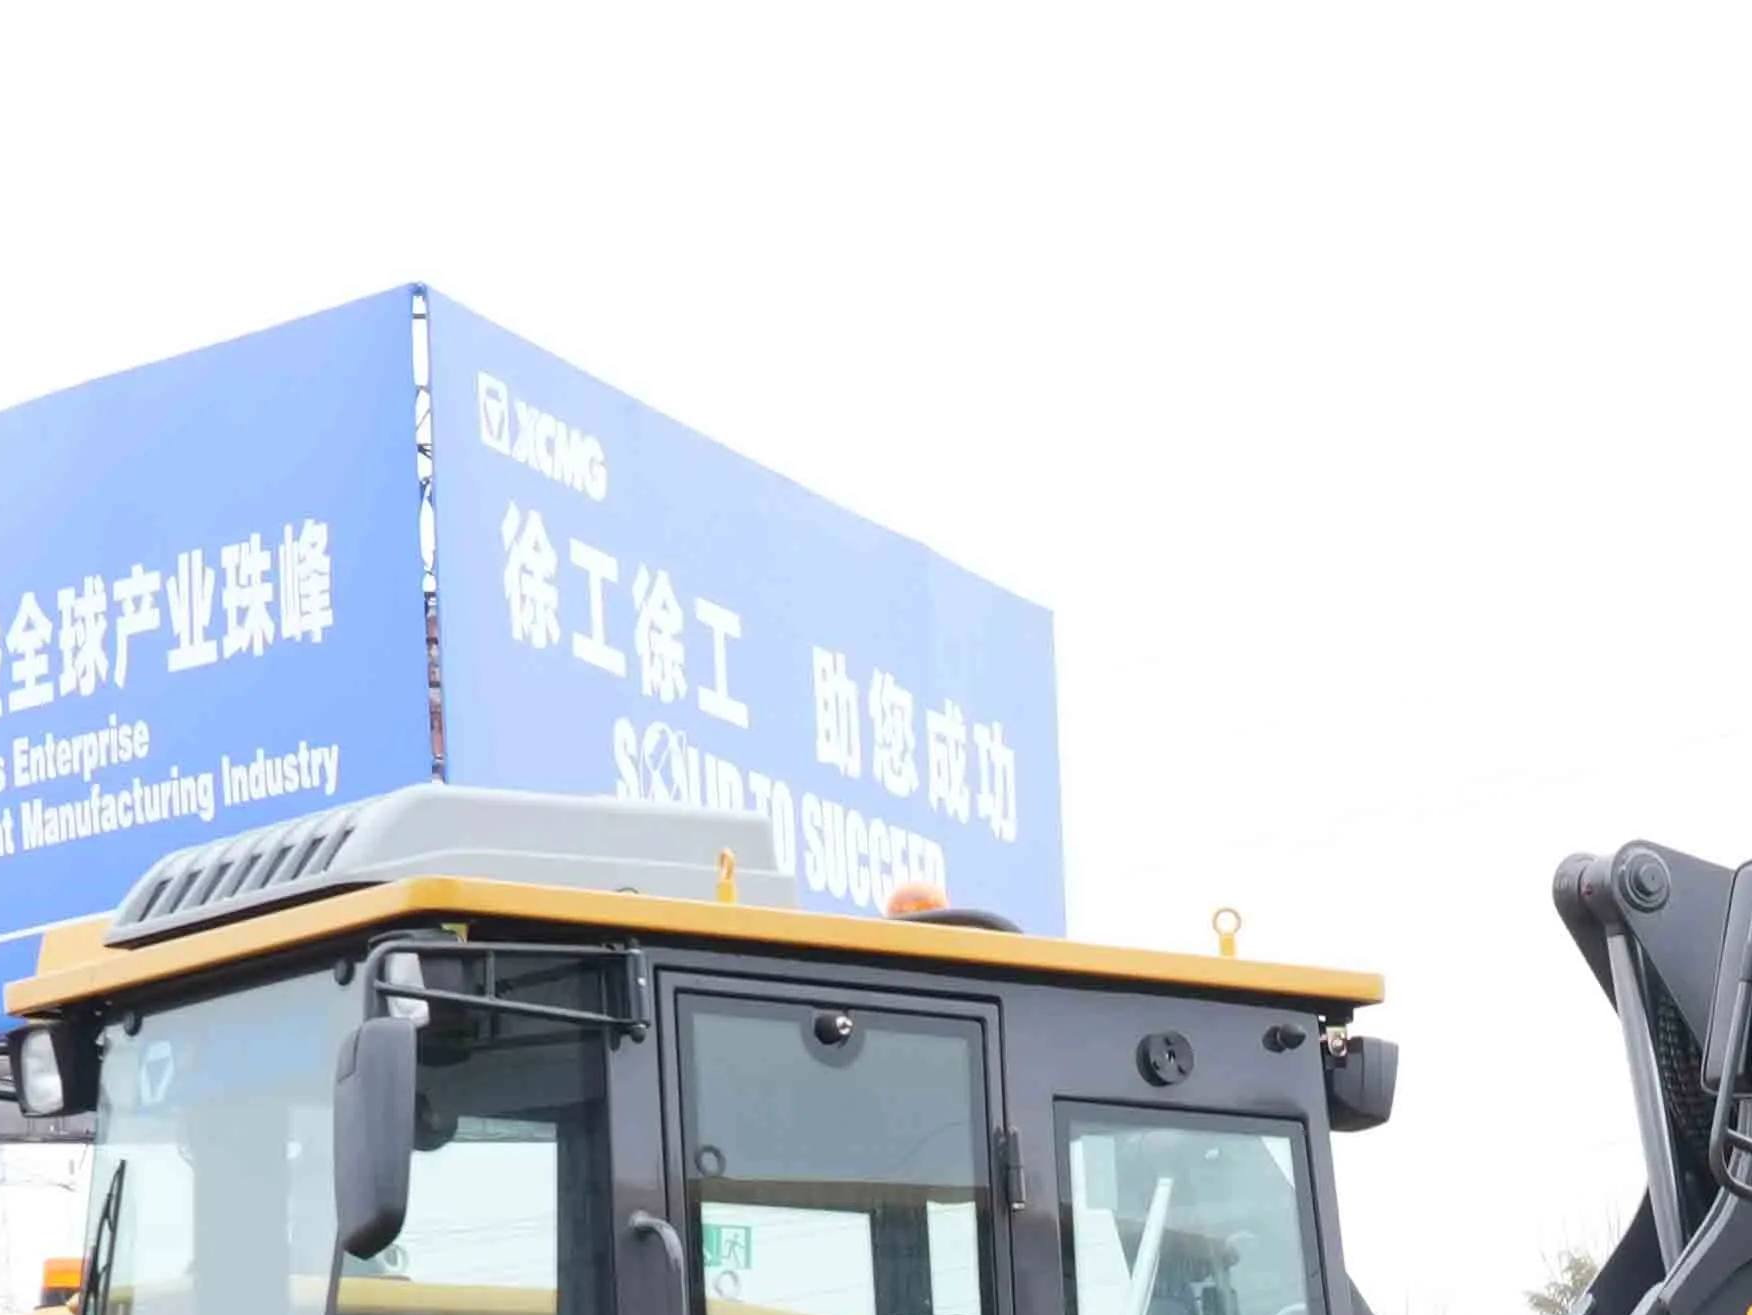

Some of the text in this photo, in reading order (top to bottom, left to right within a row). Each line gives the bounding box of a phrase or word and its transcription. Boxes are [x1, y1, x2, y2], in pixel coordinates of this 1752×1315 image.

[512, 398, 608, 502] XCMG
[501, 499, 1017, 843] 徐工徐工 助您成功
[12, 713, 150, 787] Enterprise
[20, 765, 215, 850] Manufacturing
[221, 740, 339, 806] Industry
